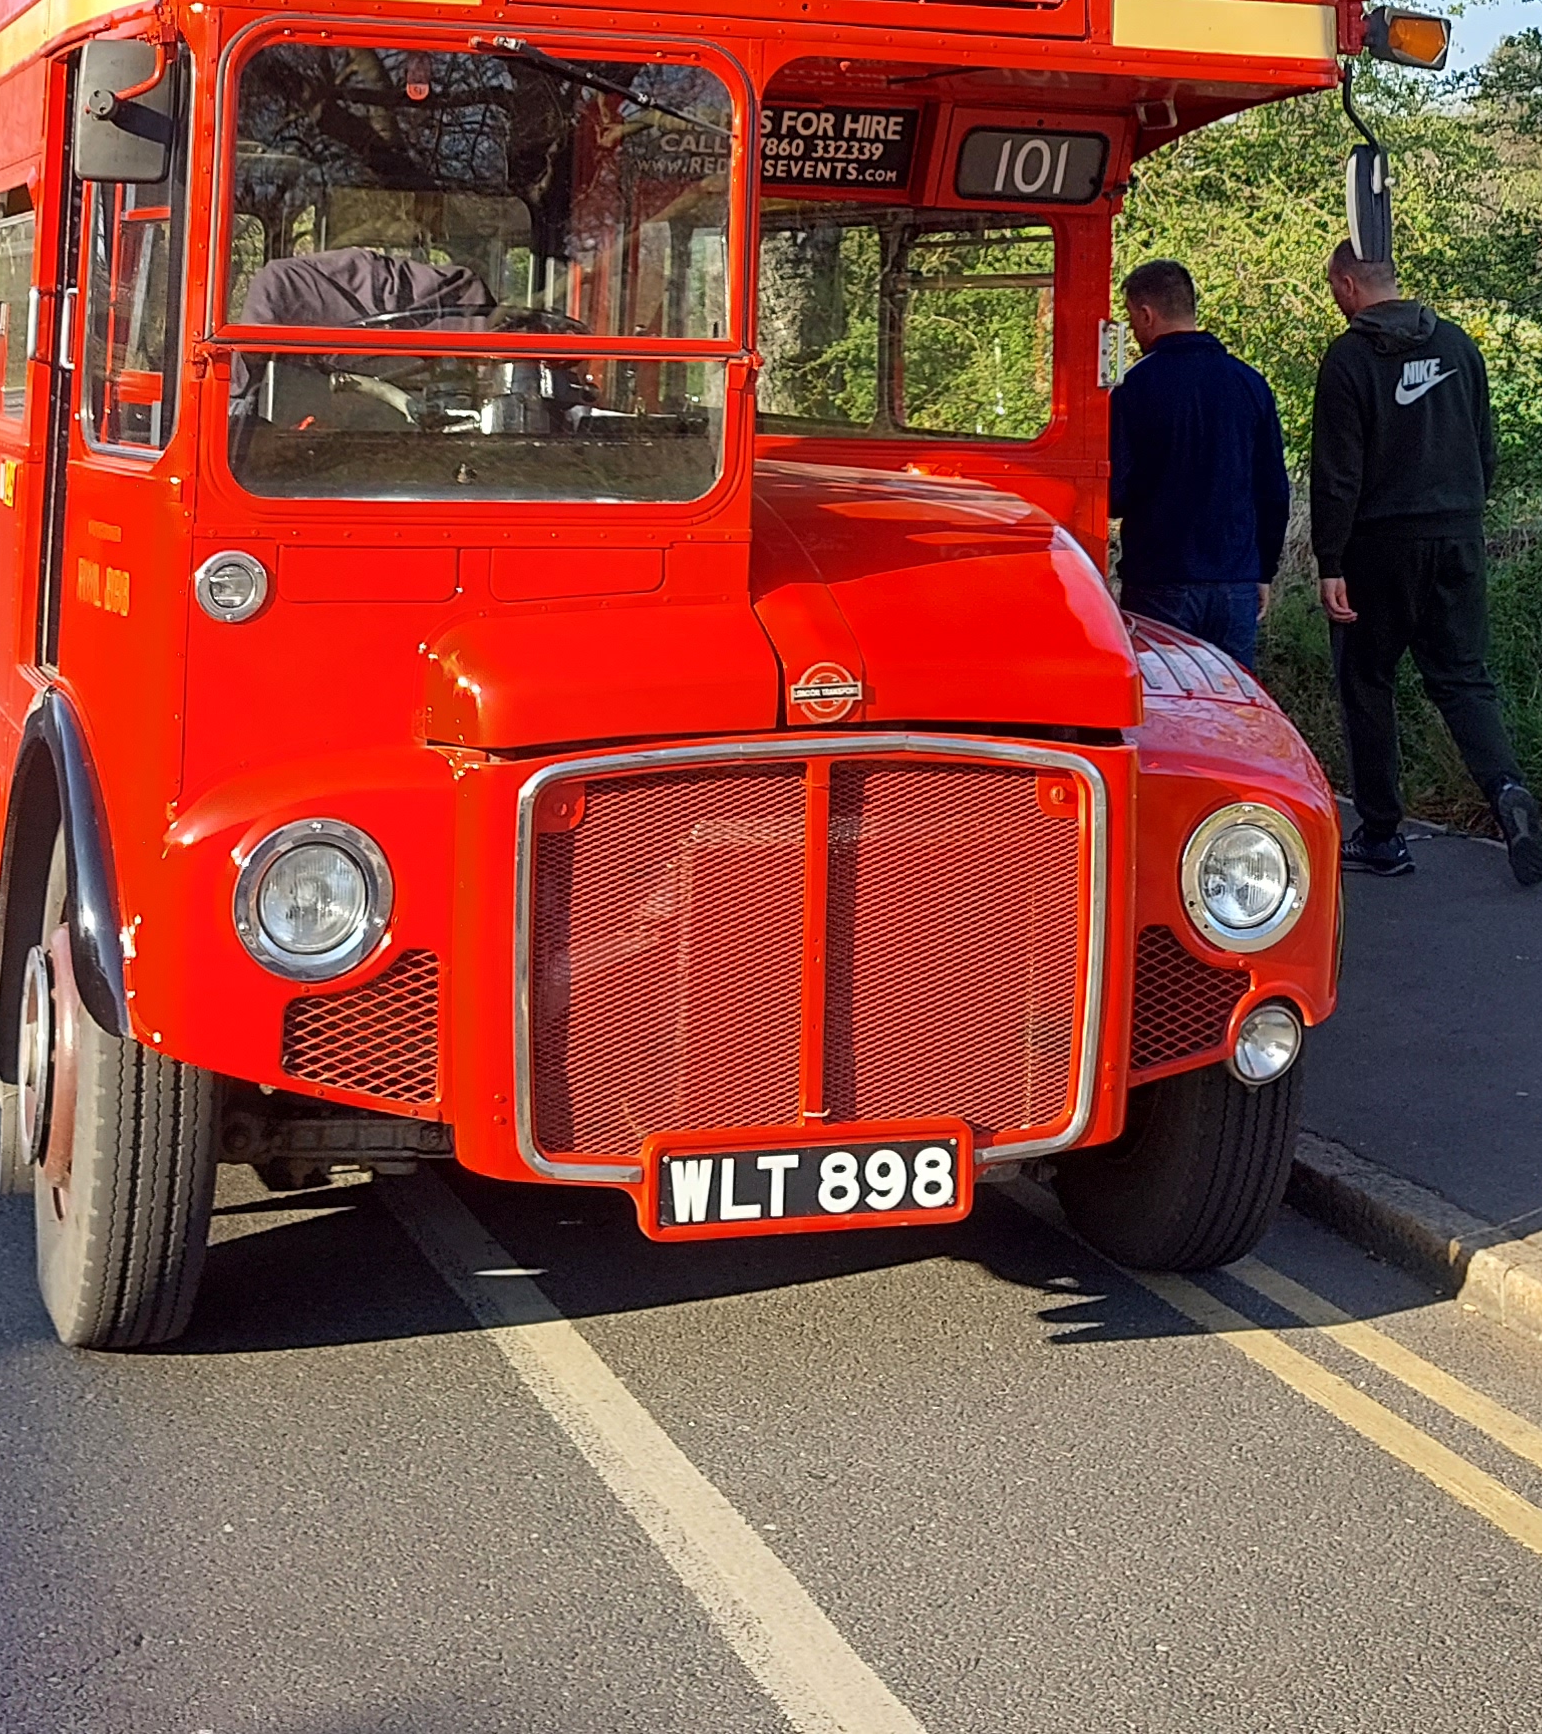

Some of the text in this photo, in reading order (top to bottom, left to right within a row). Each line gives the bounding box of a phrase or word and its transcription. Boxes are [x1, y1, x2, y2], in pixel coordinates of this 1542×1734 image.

[781, 111, 836, 140] FOR
[843, 114, 904, 140] HIRE
[660, 132, 729, 154] CALL
[811, 139, 884, 161] 332339
[994, 138, 1072, 194] 101
[1402, 357, 1441, 386] NIKE
[670, 1146, 954, 1223] WLT 898
